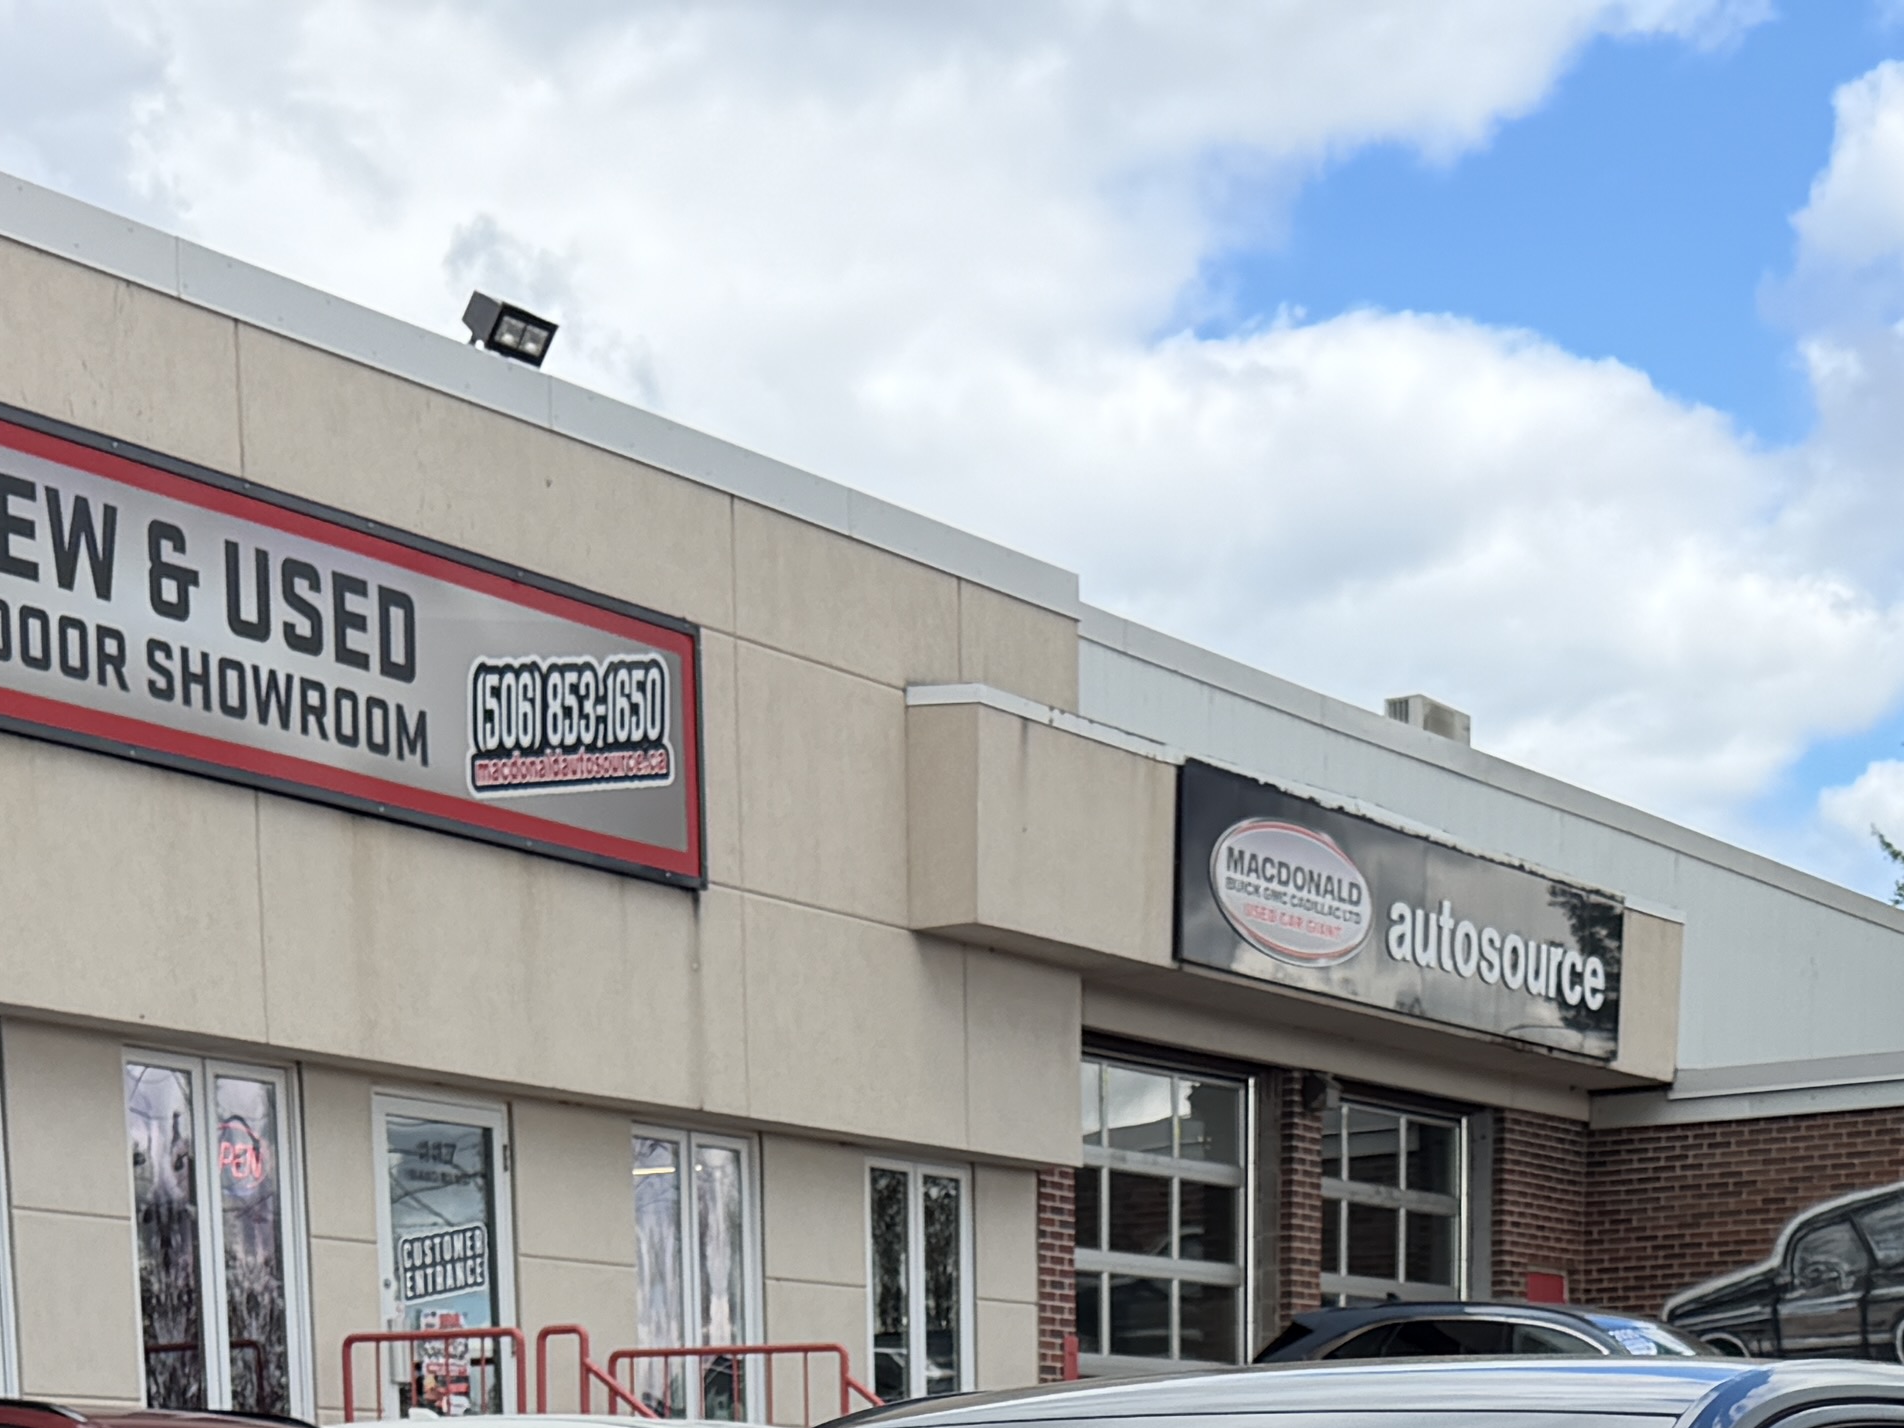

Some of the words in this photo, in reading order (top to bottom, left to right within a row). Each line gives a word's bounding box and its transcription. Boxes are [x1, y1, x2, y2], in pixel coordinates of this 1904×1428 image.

[147, 519, 201, 622] &
[225, 538, 417, 685] USED
[147, 638, 431, 767] SHOWROOM
[476, 670, 543, 751] (506)
[546, 667, 663, 748] 853-1650
[1225, 846, 1363, 908] MACDONALD
[1225, 876, 1261, 900] BUICK
[1263, 886, 1288, 906] GMC
[1290, 893, 1342, 920] CADILLAC
[1343, 909, 1362, 925] LTD
[1243, 902, 1277, 924] USED
[1278, 911, 1303, 931] CAR
[1386, 899, 1607, 1012] autosource
[218, 1141, 263, 1179] PEN
[403, 1228, 485, 1269] CUSTOMER
[405, 1258, 484, 1298] ENTRANCE
